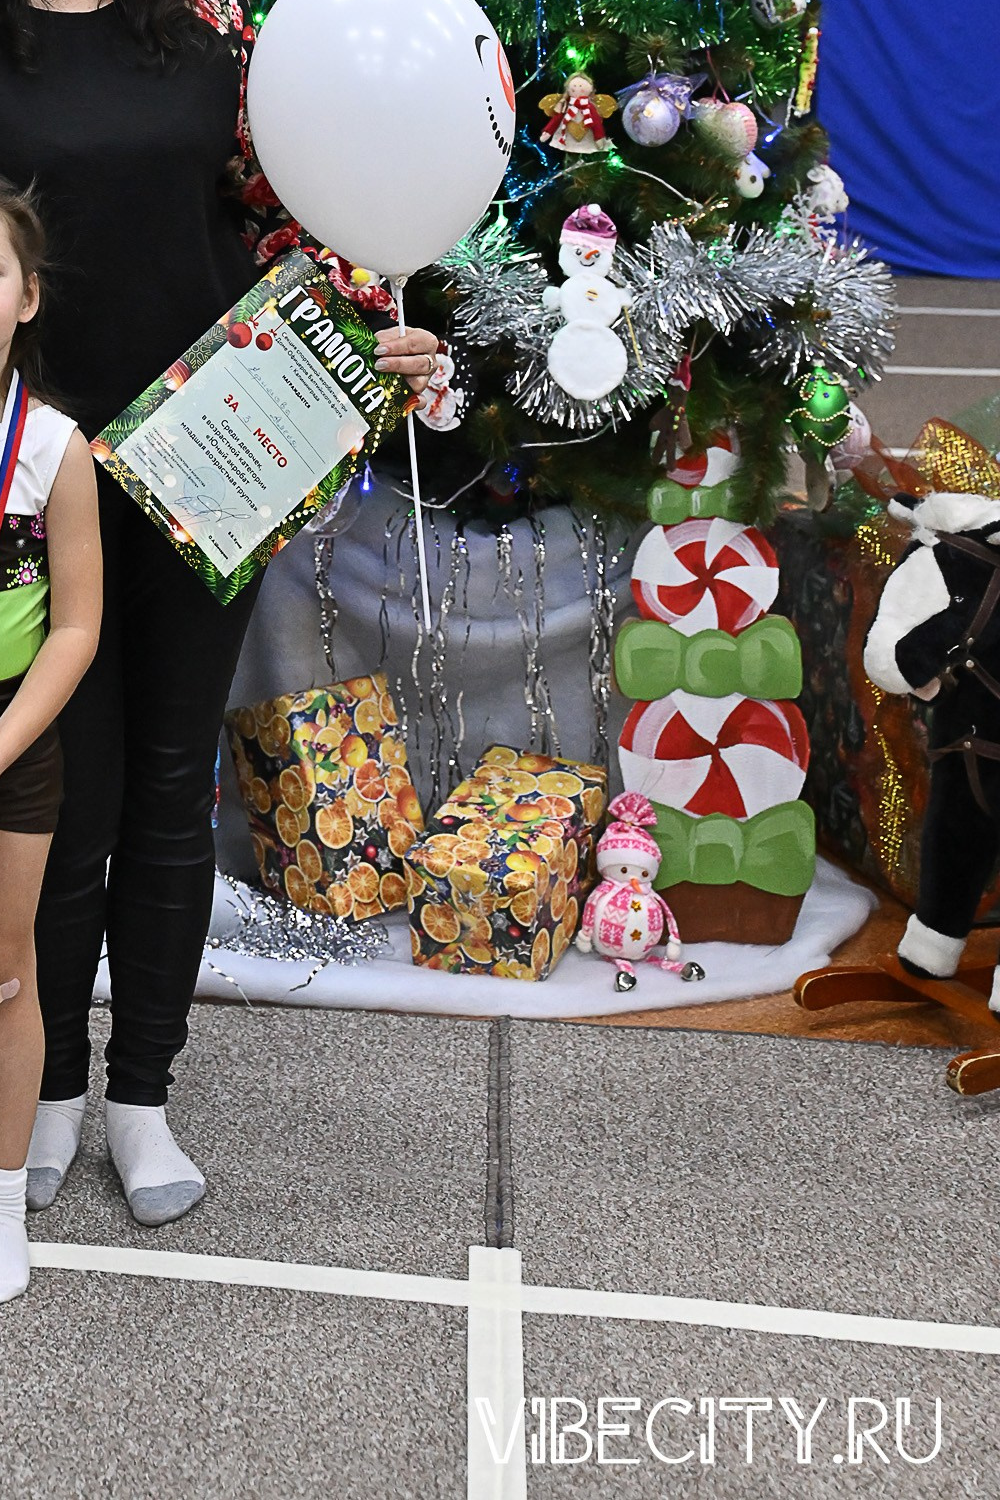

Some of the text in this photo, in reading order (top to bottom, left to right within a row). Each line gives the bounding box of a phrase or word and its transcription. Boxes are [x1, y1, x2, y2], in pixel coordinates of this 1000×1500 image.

[278, 285, 386, 414] ГРАМОТА
[281, 374, 311, 408] НАГРАЖДАЕТСЯ
[179, 421, 206, 451] младшая
[204, 449, 237, 487] возрастная
[234, 485, 258, 512] группа»
[204, 432, 250, 485] «Юный акробат
[205, 419, 239, 458] возрастной
[237, 457, 267, 490] категории
[219, 418, 264, 471] Среди девочек,
[223, 393, 241, 412] ЗА
[251, 427, 289, 469] МЕСТО
